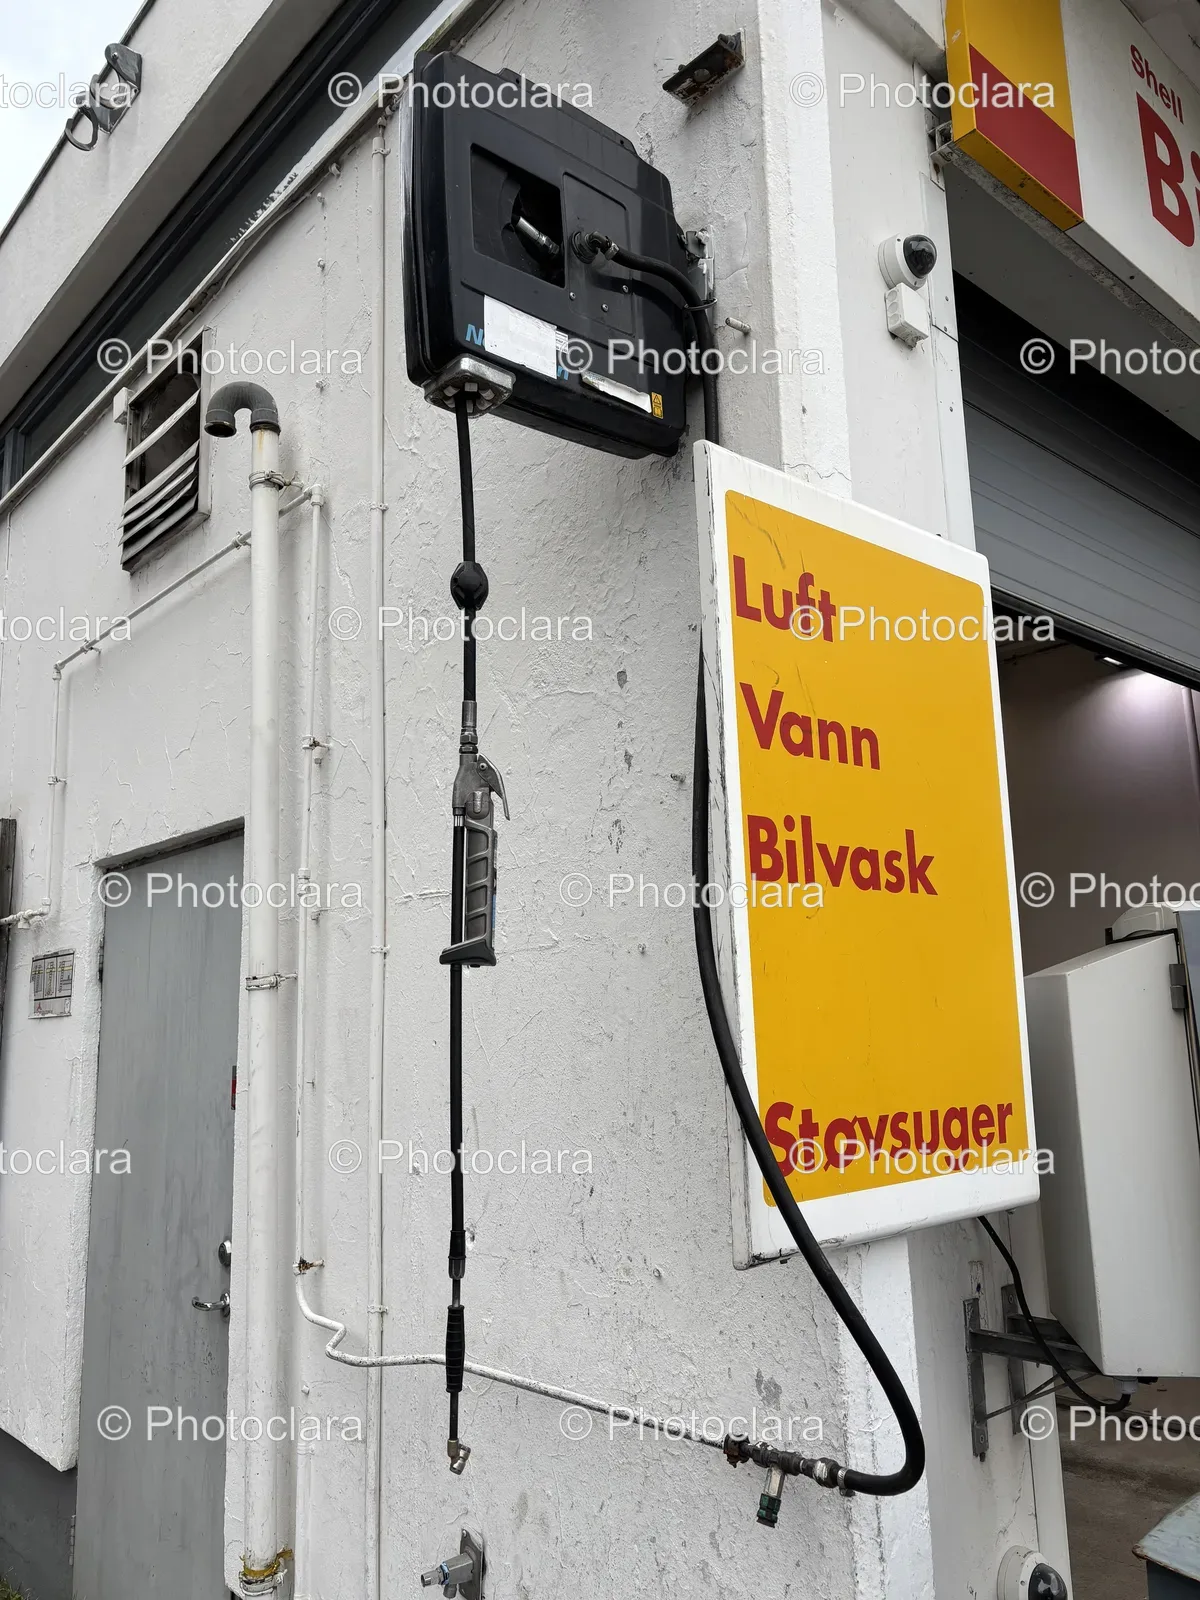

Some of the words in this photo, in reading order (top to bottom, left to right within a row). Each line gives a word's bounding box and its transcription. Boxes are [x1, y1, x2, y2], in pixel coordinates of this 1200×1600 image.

[1130, 44, 1184, 125] Shell
[733, 555, 836, 642] Luft
[739, 682, 880, 770] Vann
[747, 814, 938, 895] Bilvask
